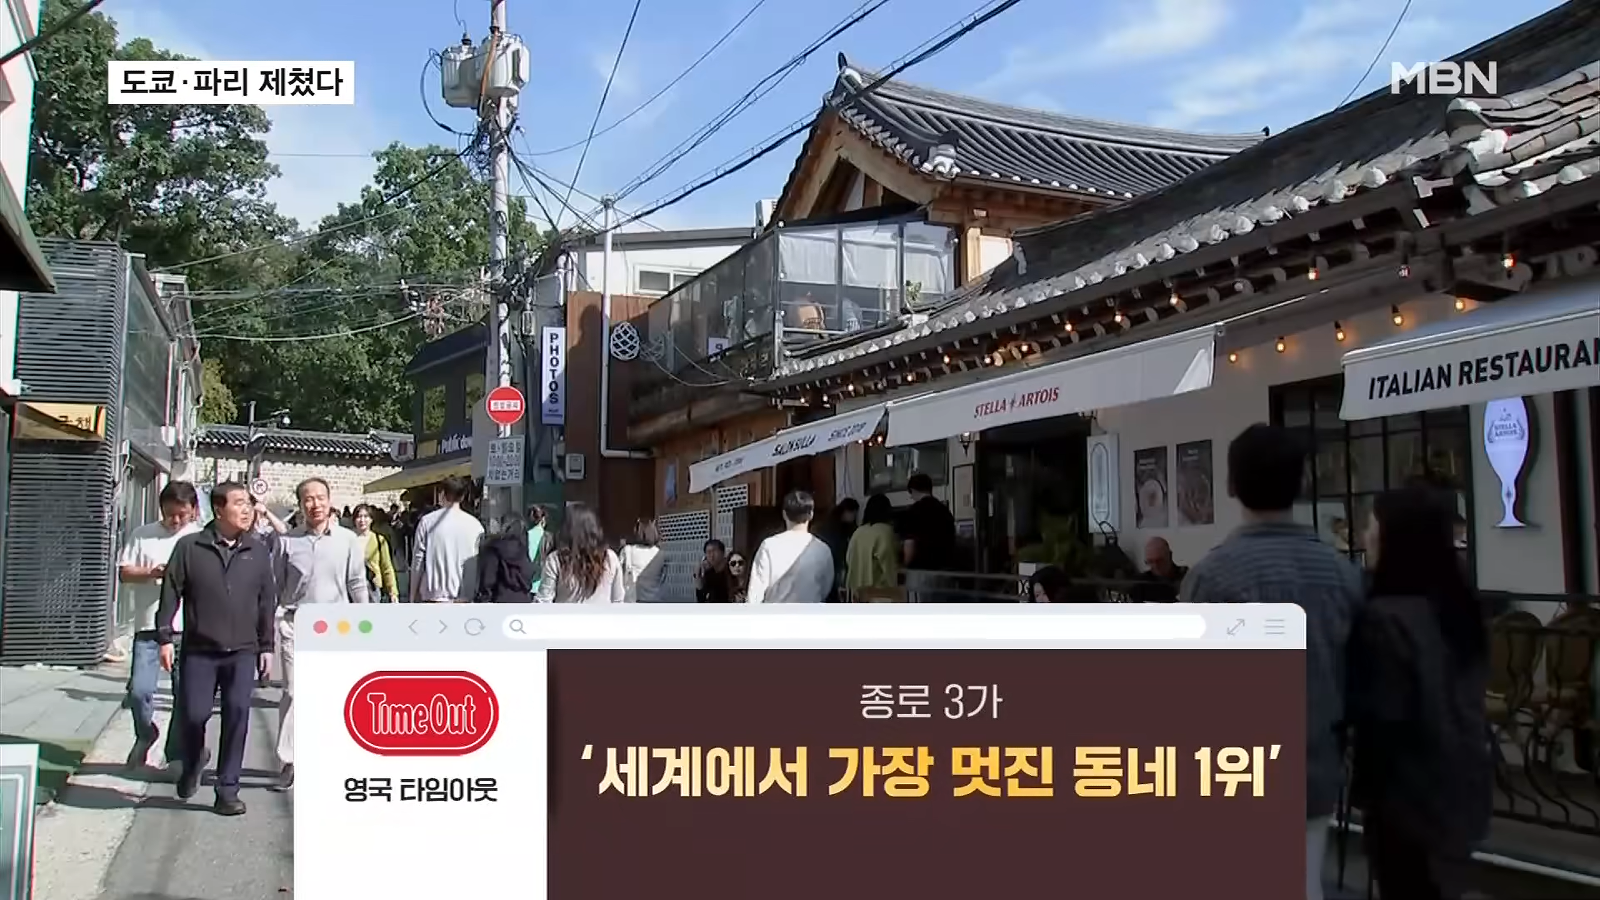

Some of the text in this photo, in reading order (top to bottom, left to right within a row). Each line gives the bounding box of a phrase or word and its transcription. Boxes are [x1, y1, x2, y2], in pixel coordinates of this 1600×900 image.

[549, 332, 560, 405] PHOTOS
[1368, 363, 1452, 400] ITALIAN
[973, 386, 1060, 419] STELLA ARTOIS
